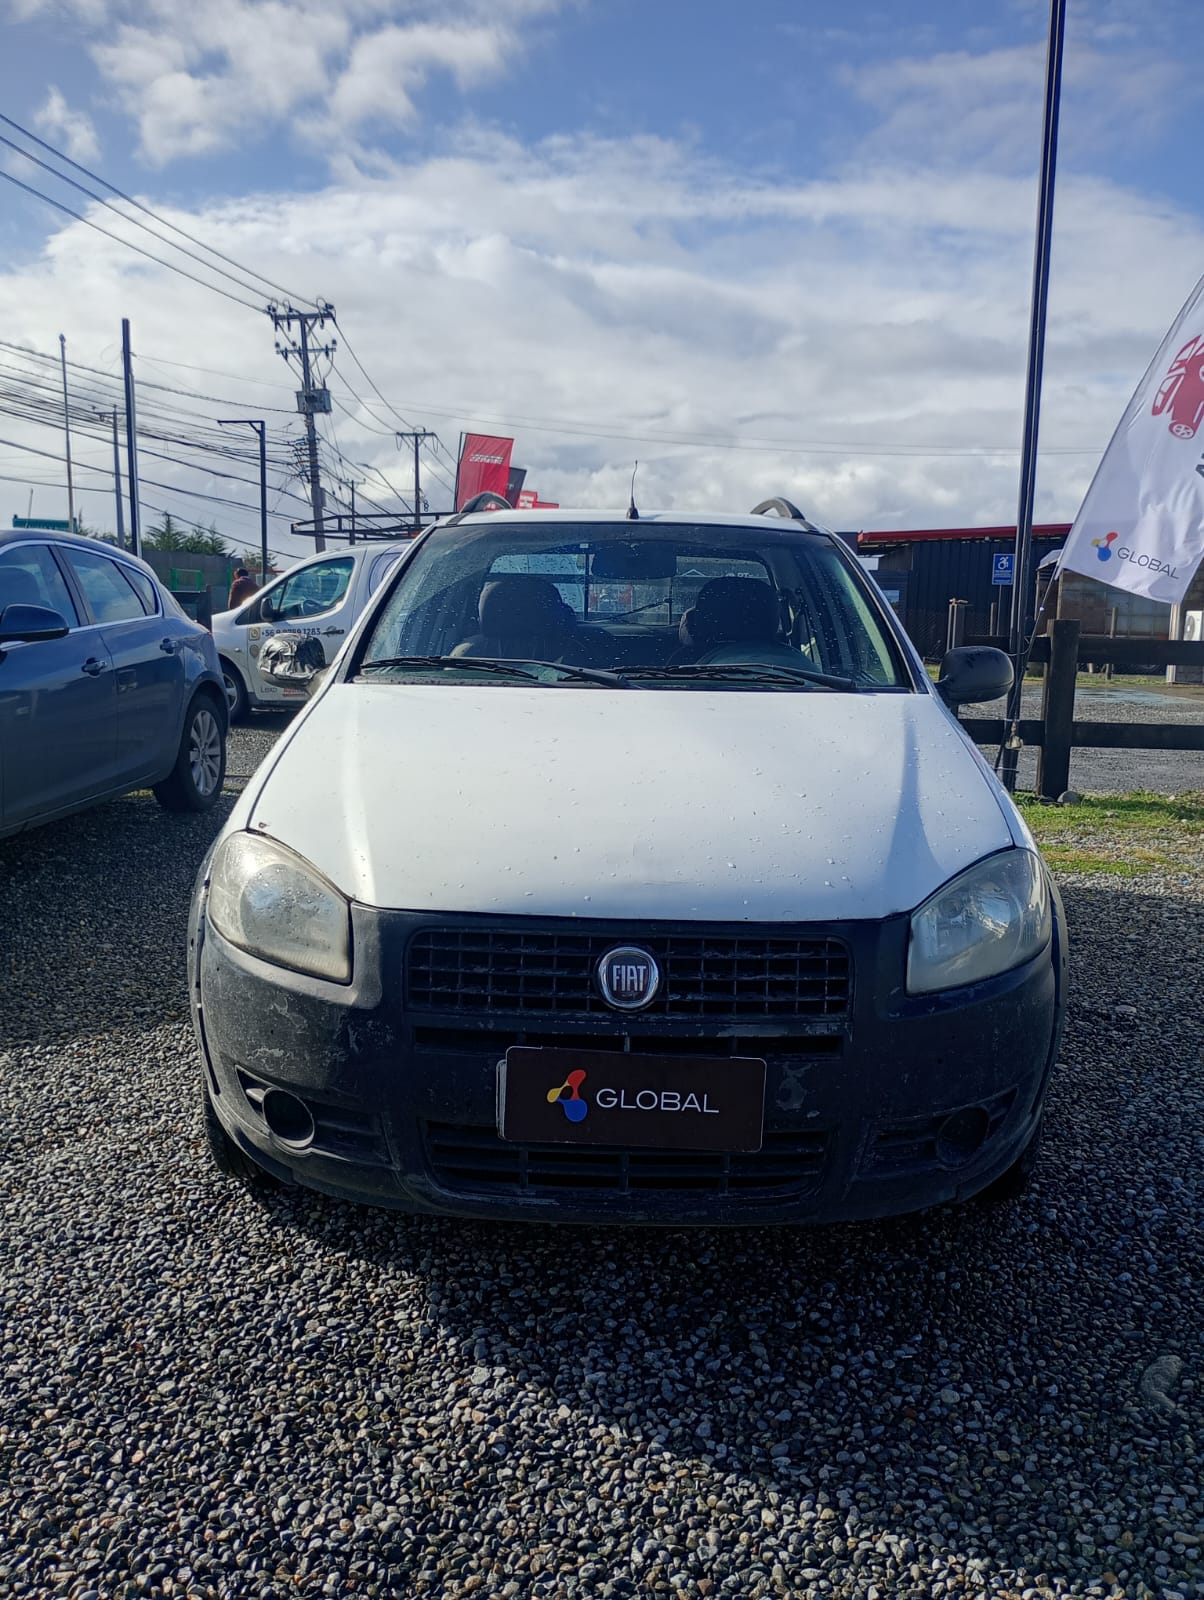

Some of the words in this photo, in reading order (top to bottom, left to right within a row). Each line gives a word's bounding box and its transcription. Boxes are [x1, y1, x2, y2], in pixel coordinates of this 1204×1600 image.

[1117, 547, 1180, 580] GLOBAL
[612, 965, 647, 992] FIAT
[596, 1088, 720, 1113] GLOBAL
